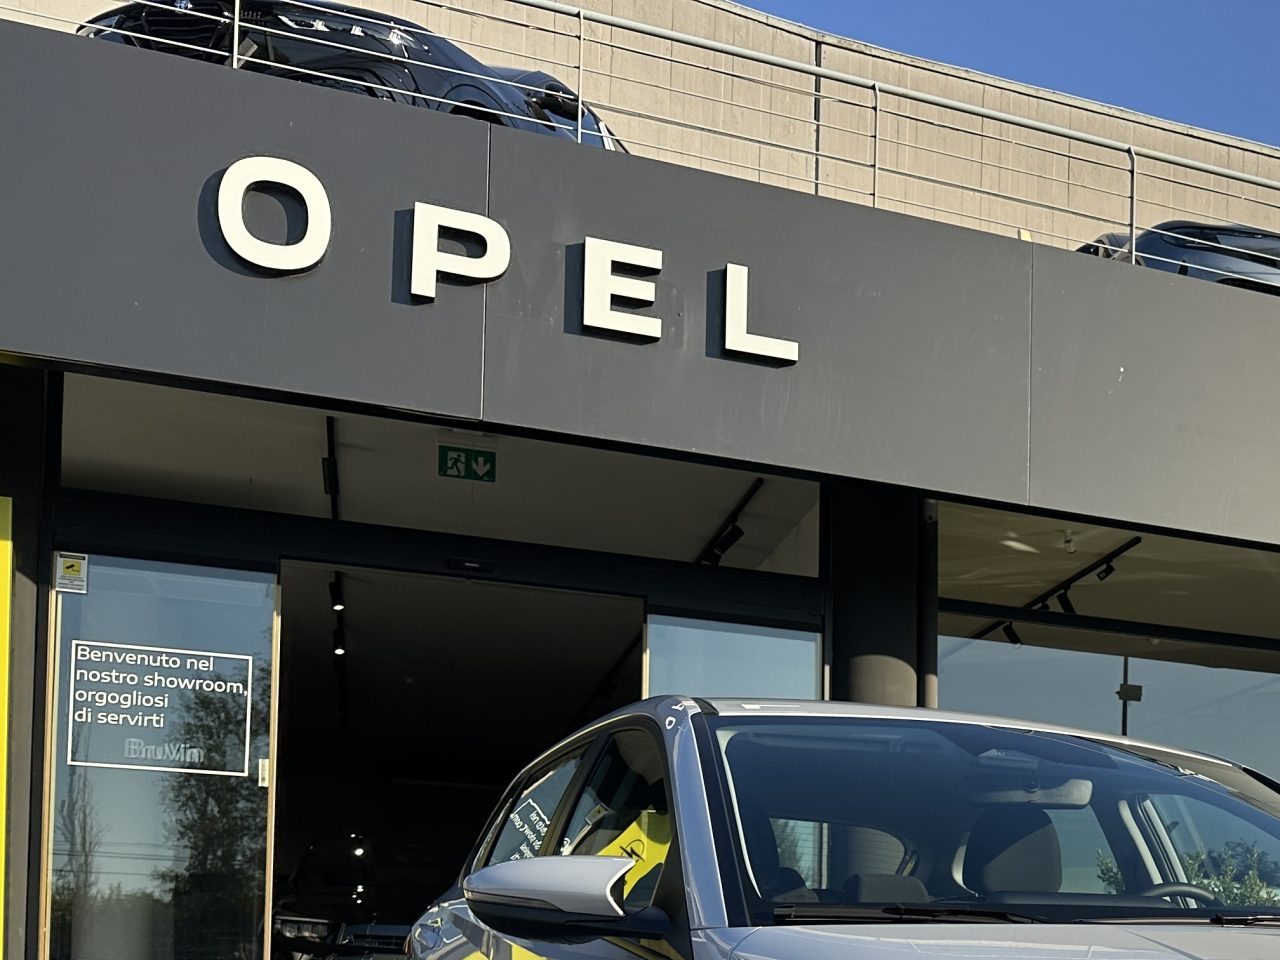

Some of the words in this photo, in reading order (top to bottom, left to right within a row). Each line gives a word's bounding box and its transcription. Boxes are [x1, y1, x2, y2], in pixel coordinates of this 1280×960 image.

[217, 156, 799, 363] OPEL
[76, 645, 181, 669] Benvenuto
[186, 656, 214, 672] nel
[76, 668, 139, 686] nostro
[143, 672, 249, 697] showroom,
[74, 689, 170, 709] orgogliosi
[74, 706, 93, 723] di
[97, 710, 165, 728] servirti
